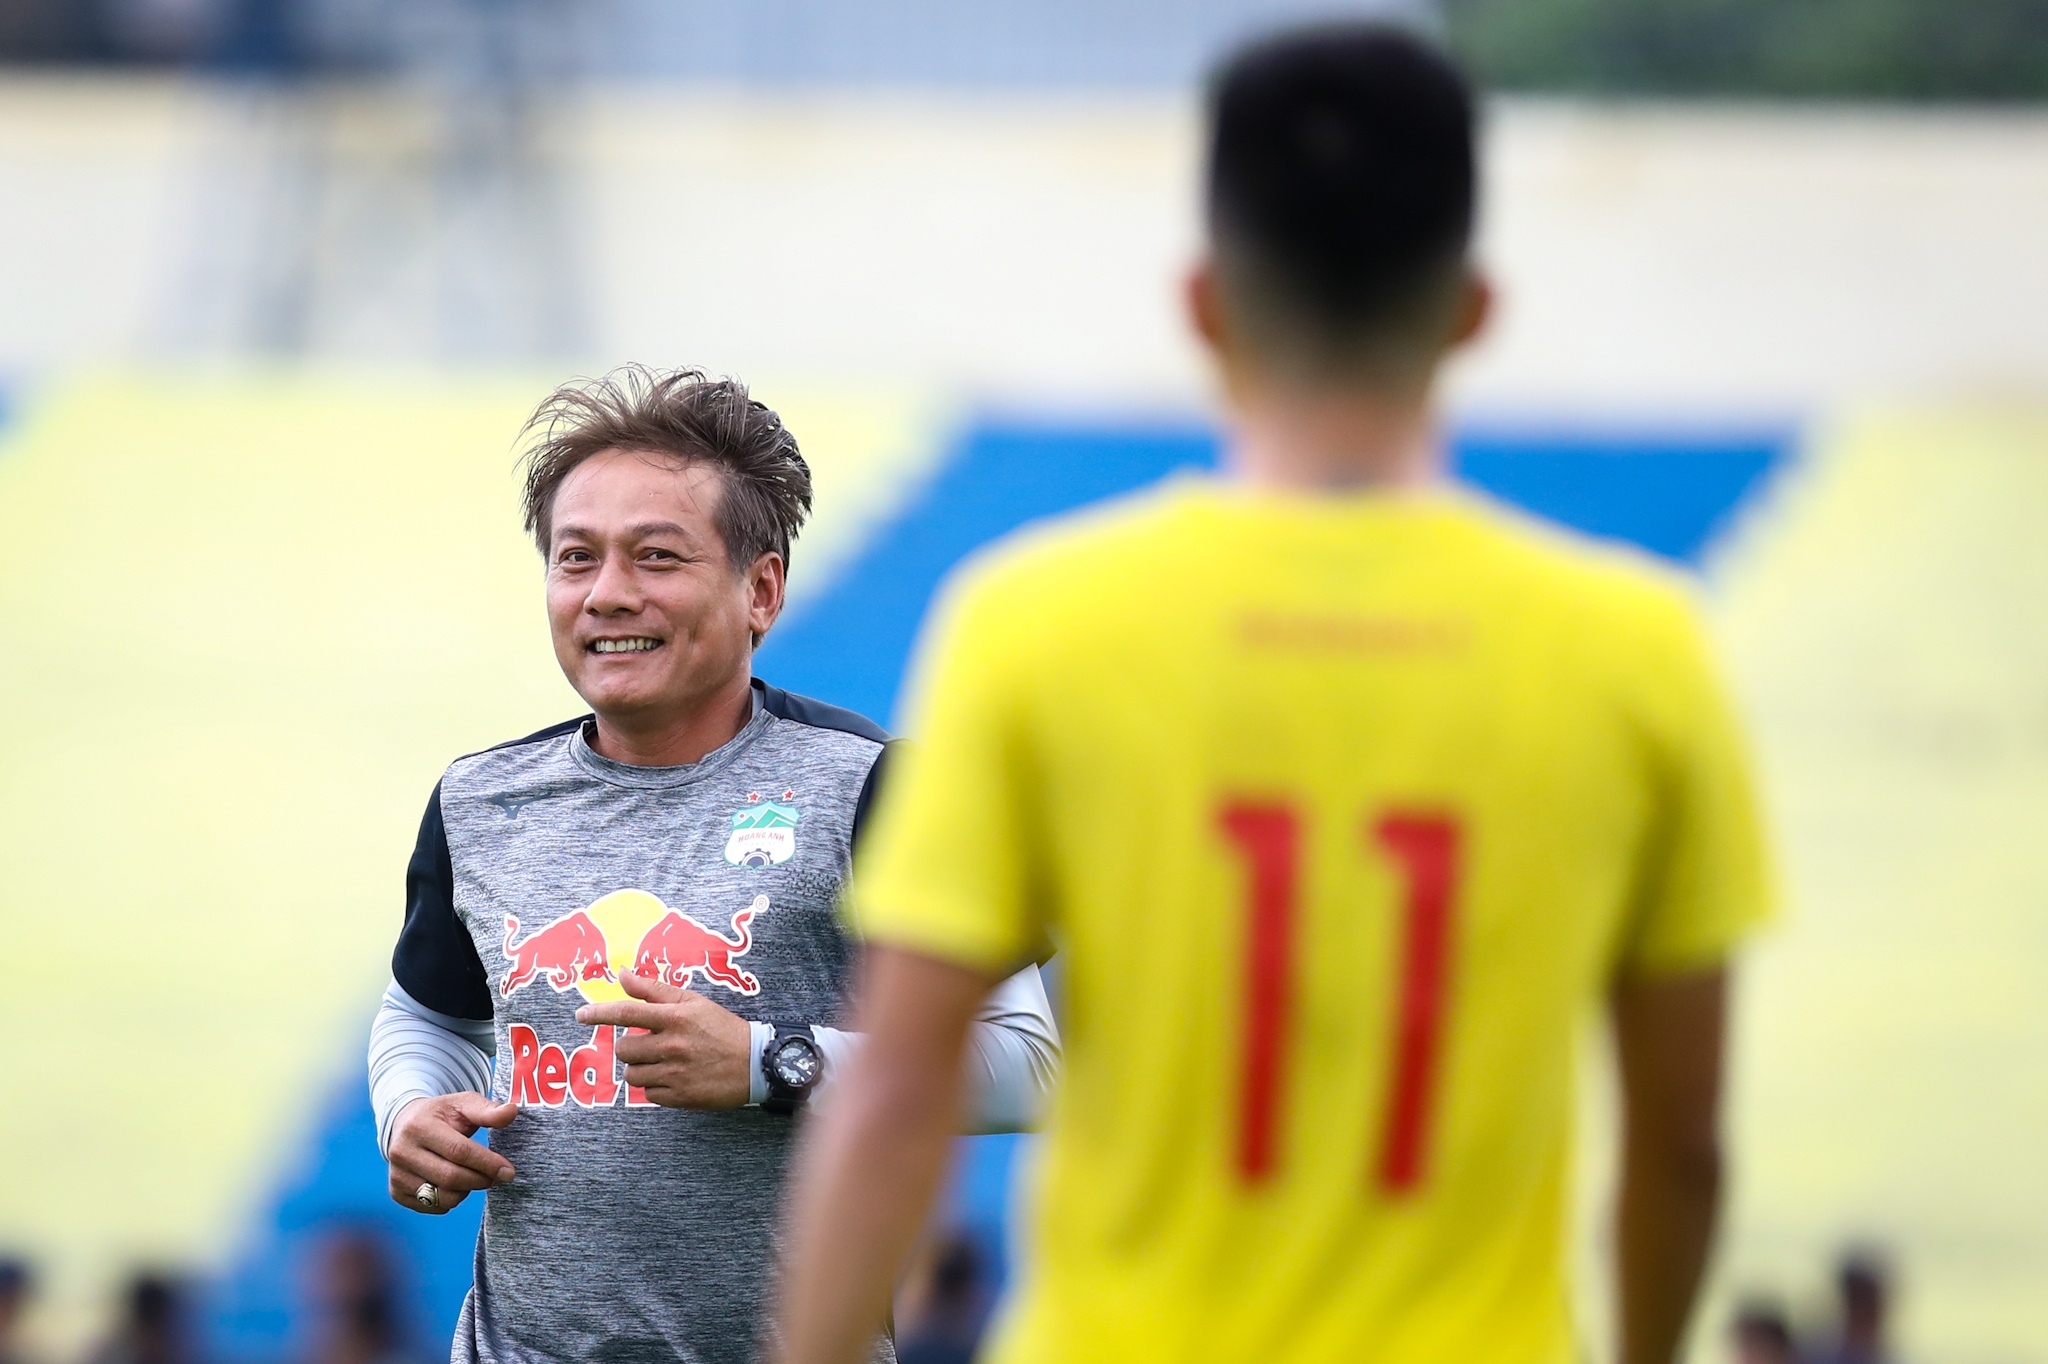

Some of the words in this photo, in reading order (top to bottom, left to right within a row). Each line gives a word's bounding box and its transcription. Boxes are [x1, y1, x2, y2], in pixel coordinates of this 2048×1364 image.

[738, 832, 766, 843] HOANG
[768, 832, 785, 842] ANH
[1214, 794, 1463, 1196] 11
[509, 1024, 620, 1106] Red
